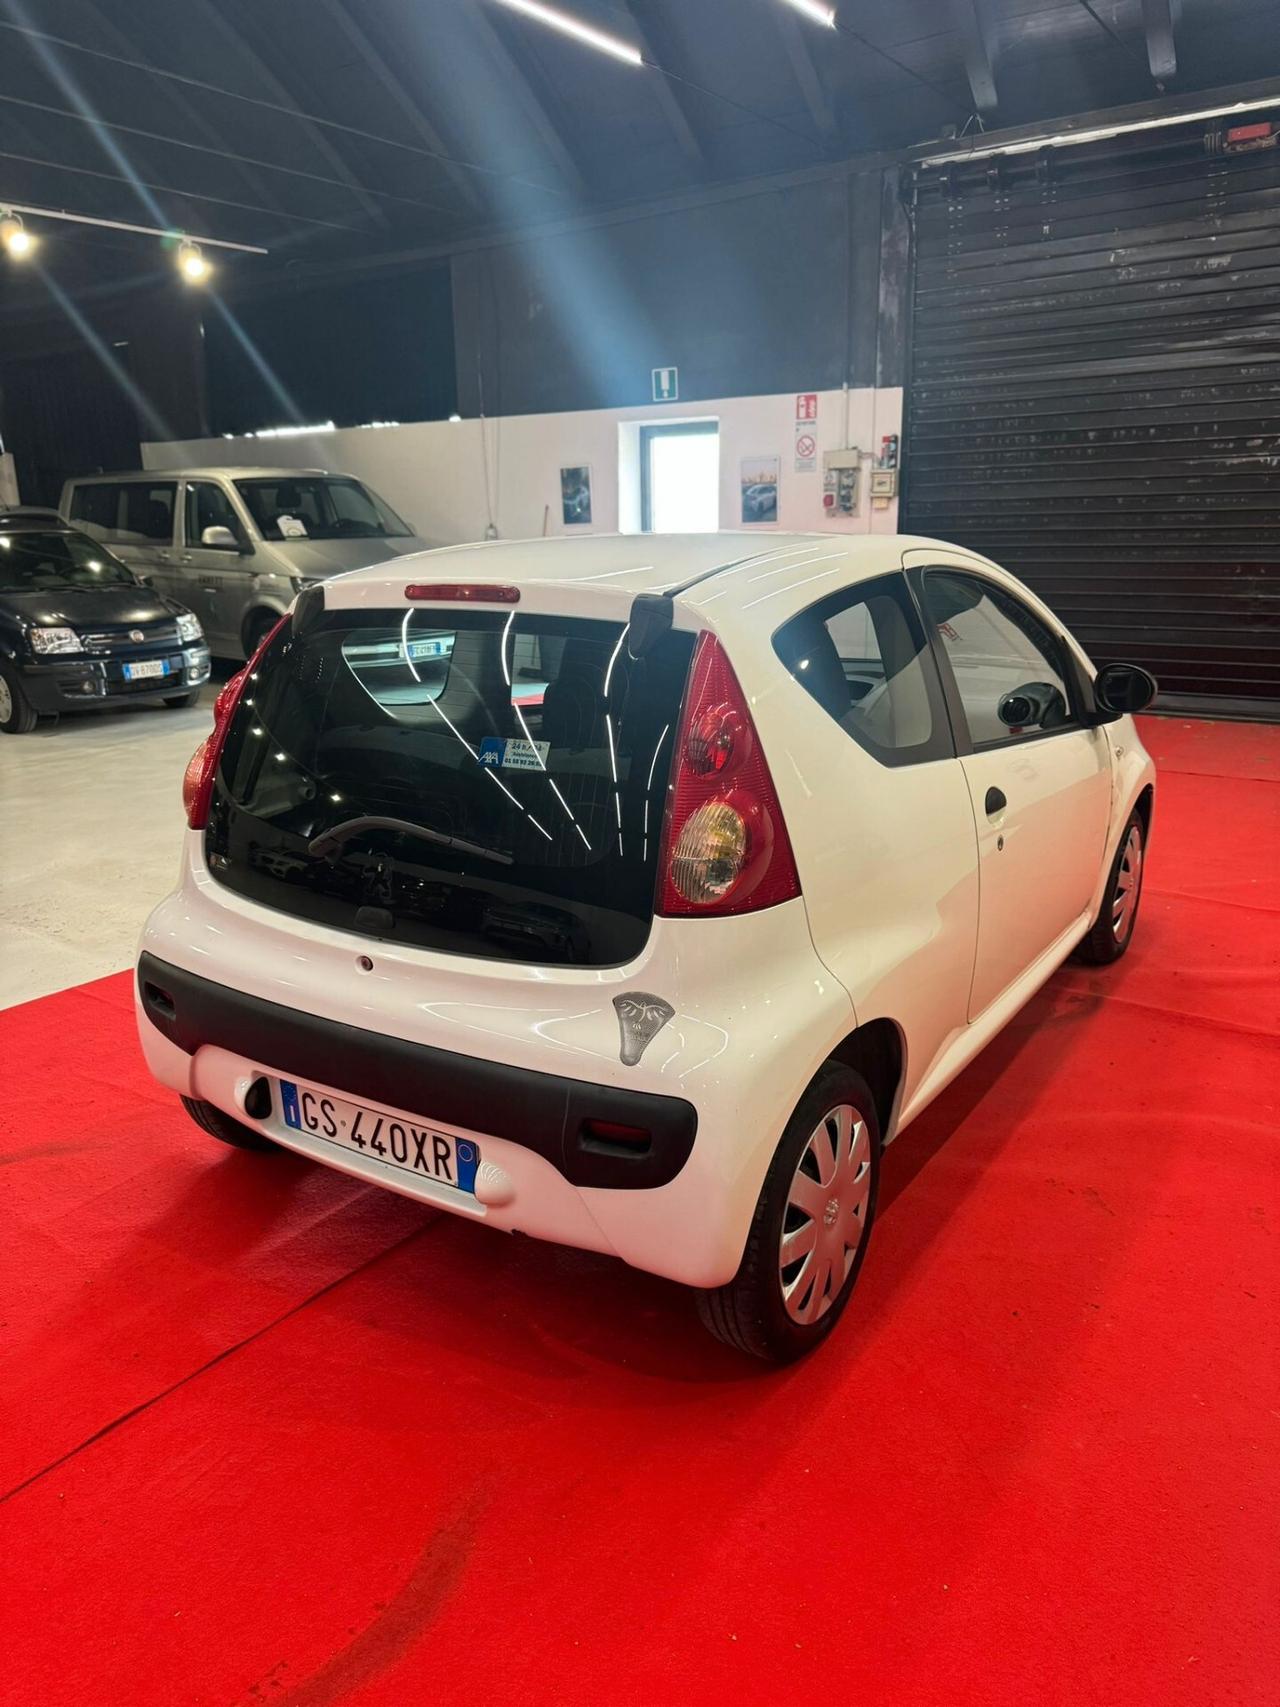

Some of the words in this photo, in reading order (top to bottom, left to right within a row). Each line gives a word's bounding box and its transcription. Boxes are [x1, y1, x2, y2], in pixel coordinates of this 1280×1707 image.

[479, 751, 499, 765] AXA
[301, 1091, 338, 1138] GS
[350, 1110, 453, 1181] 440XR
